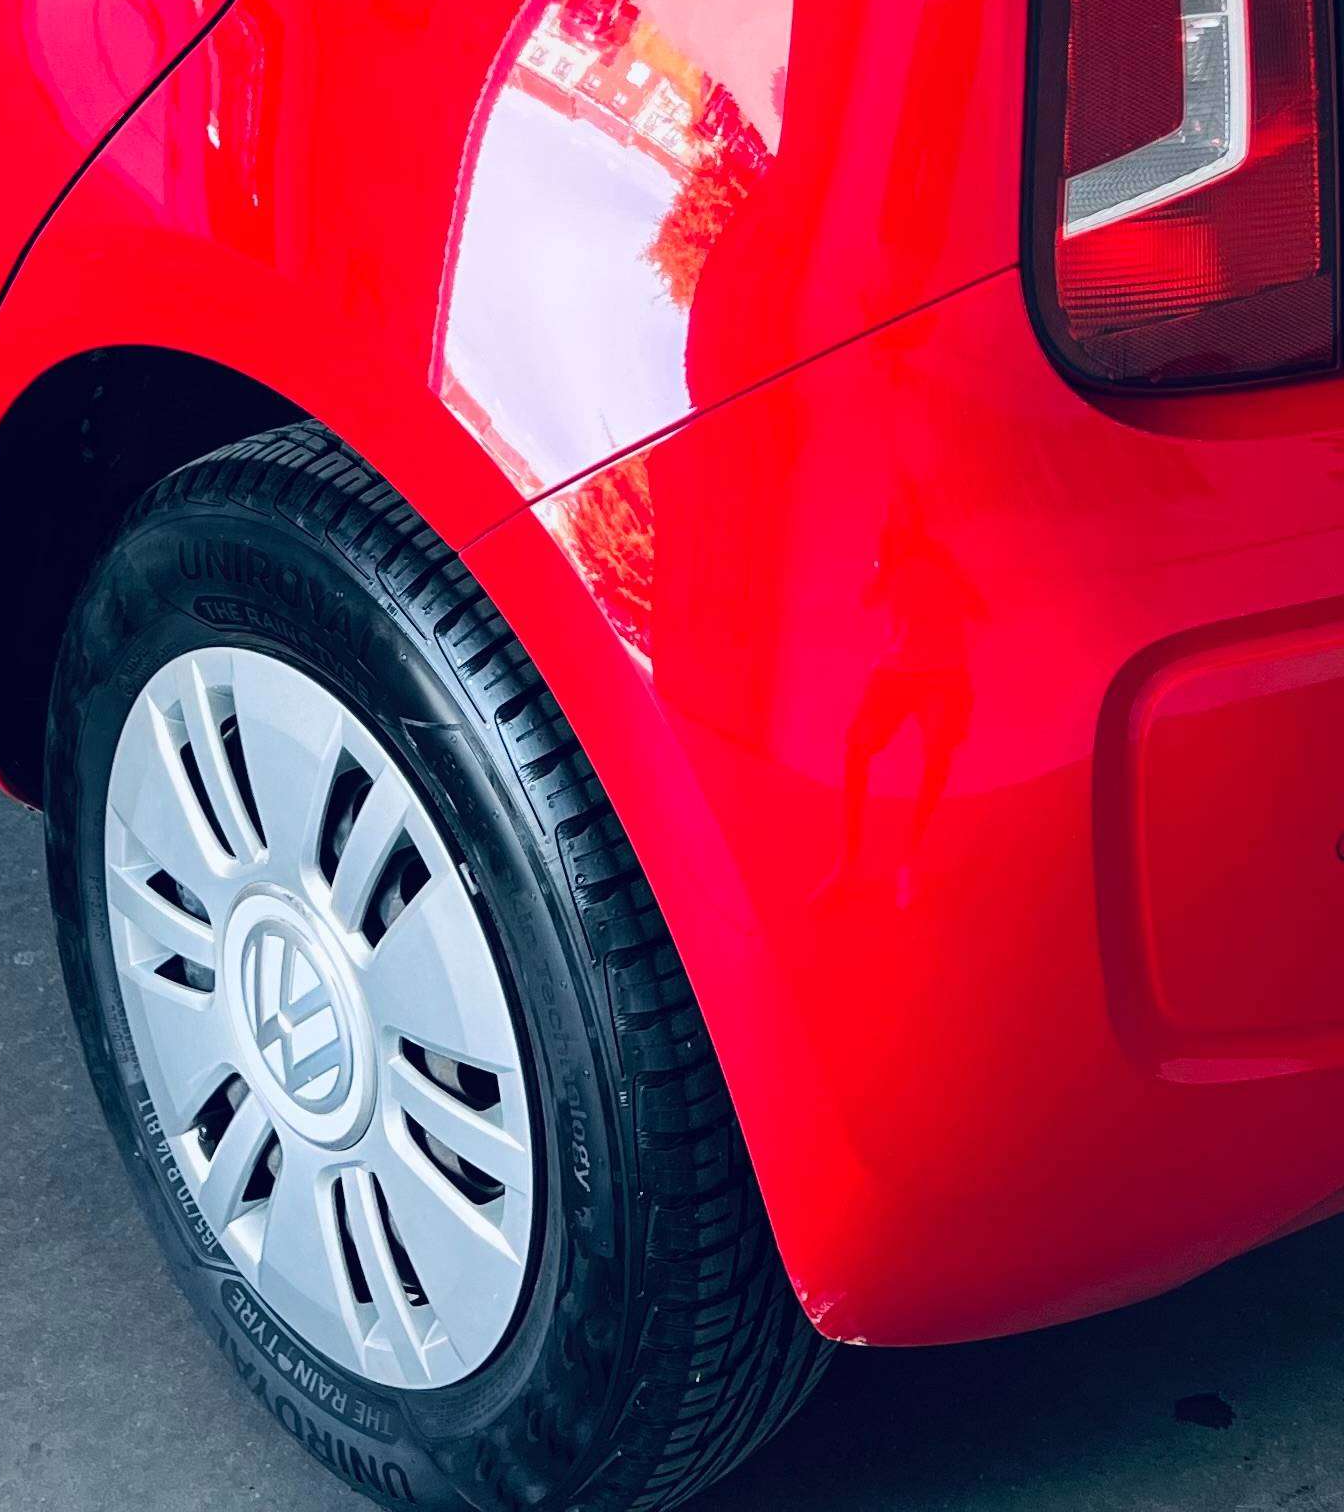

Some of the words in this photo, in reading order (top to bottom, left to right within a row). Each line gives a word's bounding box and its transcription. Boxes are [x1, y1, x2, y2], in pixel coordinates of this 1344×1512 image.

[201, 600, 241, 622] THE
[227, 1287, 279, 1359] TYRE
[292, 1359, 349, 1415] RAIN
[352, 1399, 393, 1437] THE
